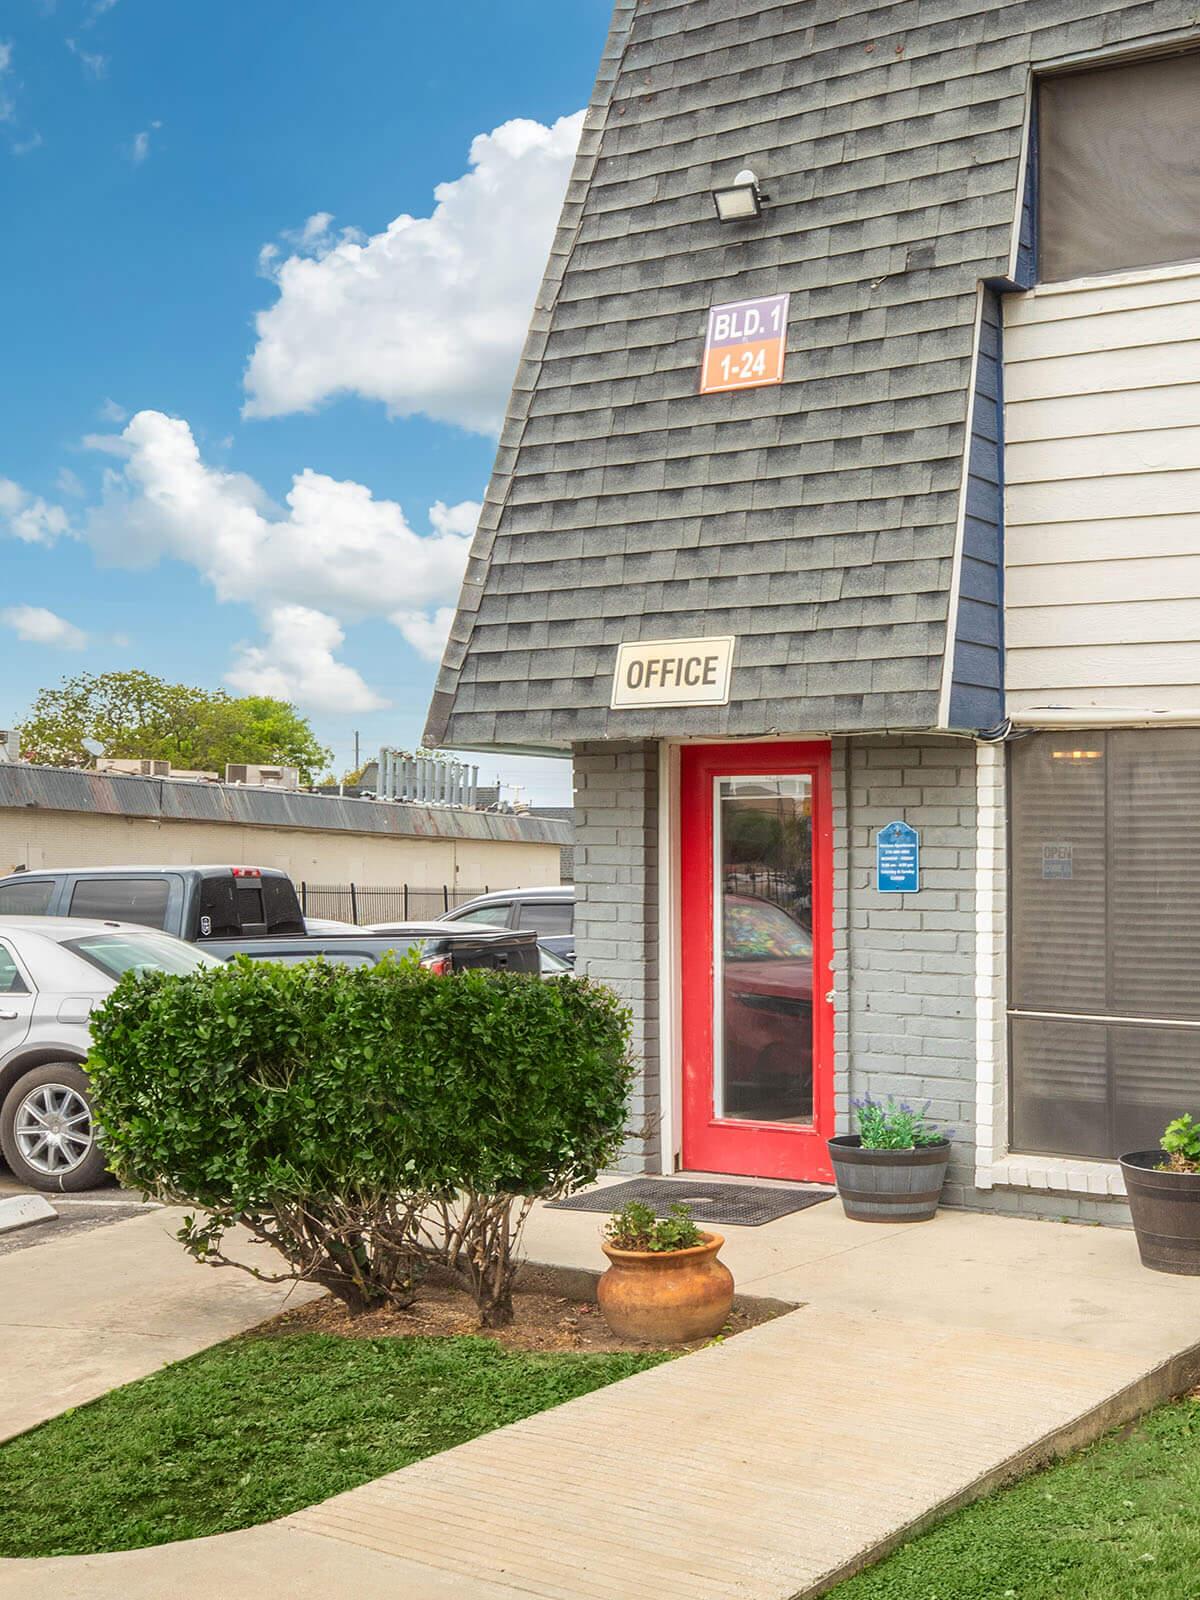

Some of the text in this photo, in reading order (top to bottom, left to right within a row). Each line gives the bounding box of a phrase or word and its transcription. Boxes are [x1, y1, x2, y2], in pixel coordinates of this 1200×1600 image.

[714, 305, 780, 341] BLD. 1
[721, 349, 765, 381] 1-24
[627, 656, 718, 689] OFFICE
[1044, 847, 1071, 858] OPEN
